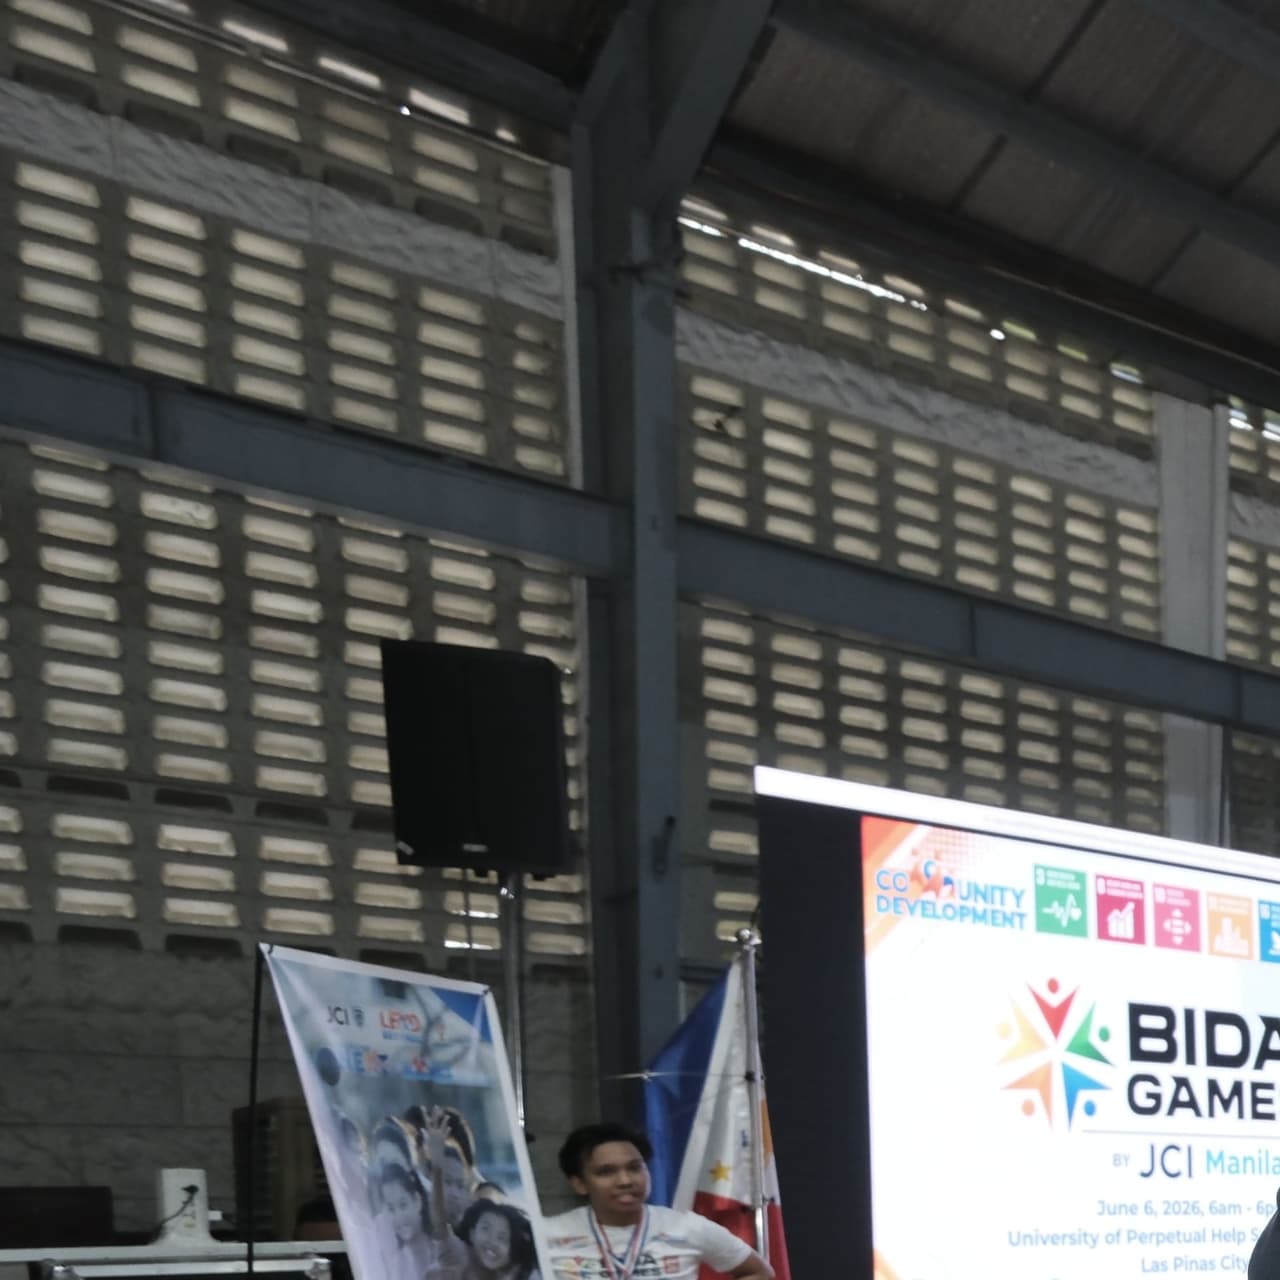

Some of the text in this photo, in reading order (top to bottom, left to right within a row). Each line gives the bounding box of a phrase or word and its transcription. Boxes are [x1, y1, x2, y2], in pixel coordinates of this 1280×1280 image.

[876, 862, 1025, 910] COUNITY
[876, 894, 1028, 930] DEVELOPMENT
[1112, 1153, 1131, 1168] BY
[1139, 1143, 1193, 1179] JCI
[1096, 1199, 1139, 1217] June
[1143, 1200, 1158, 1219] 6,
[1162, 1199, 1205, 1218] 2026,
[1208, 1199, 1242, 1216] 6am
[1008, 1228, 1099, 1249] University
[1105, 1228, 1122, 1245] of
[1127, 1226, 1207, 1247] Perpetual
[1211, 1226, 1246, 1246] Help
[1141, 1254, 1249, 1275] Las Pinas City
